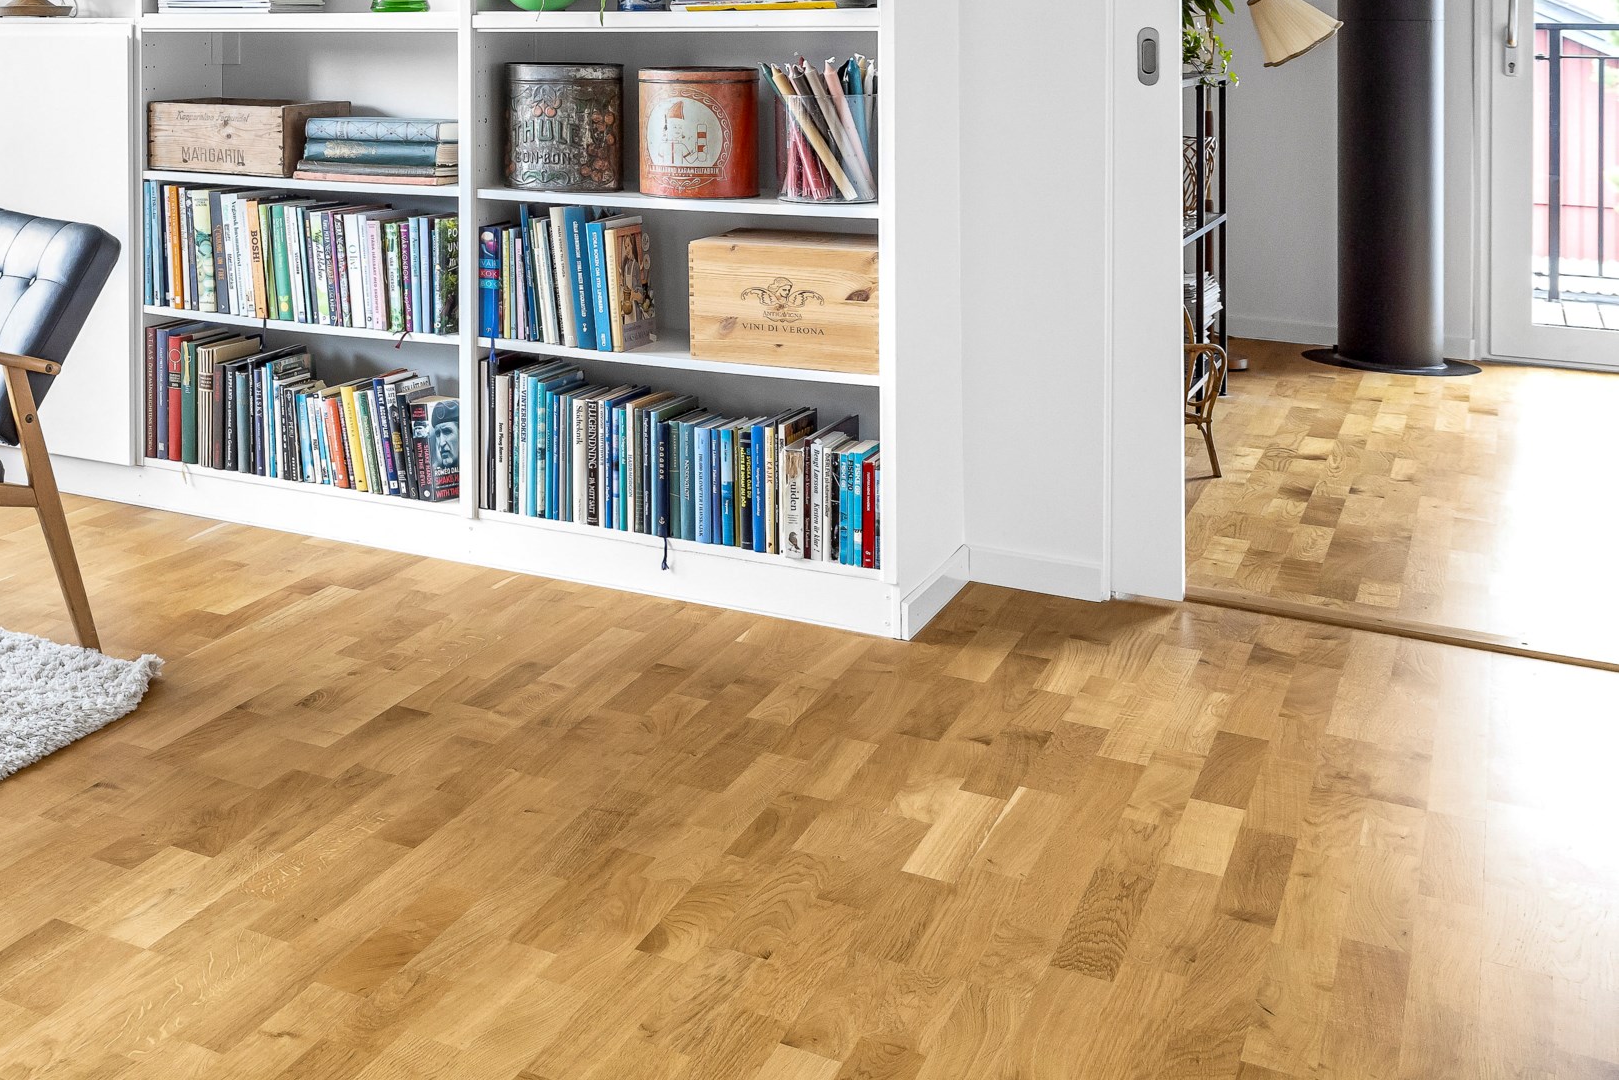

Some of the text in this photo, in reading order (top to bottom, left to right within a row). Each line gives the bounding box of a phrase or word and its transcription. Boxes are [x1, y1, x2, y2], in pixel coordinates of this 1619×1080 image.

[513, 119, 583, 147] THULE
[182, 146, 245, 163] MARGARIN
[250, 230, 260, 263] BOSH!
[595, 267, 600, 276] OM
[782, 326, 825, 335] VERONA
[380, 406, 389, 438] ACCOMPLICE
[588, 402, 596, 469] FLUGBINDNING
[848, 482, 854, 491] 70
[436, 489, 450, 498] WITH
[747, 490, 752, 498] DU
